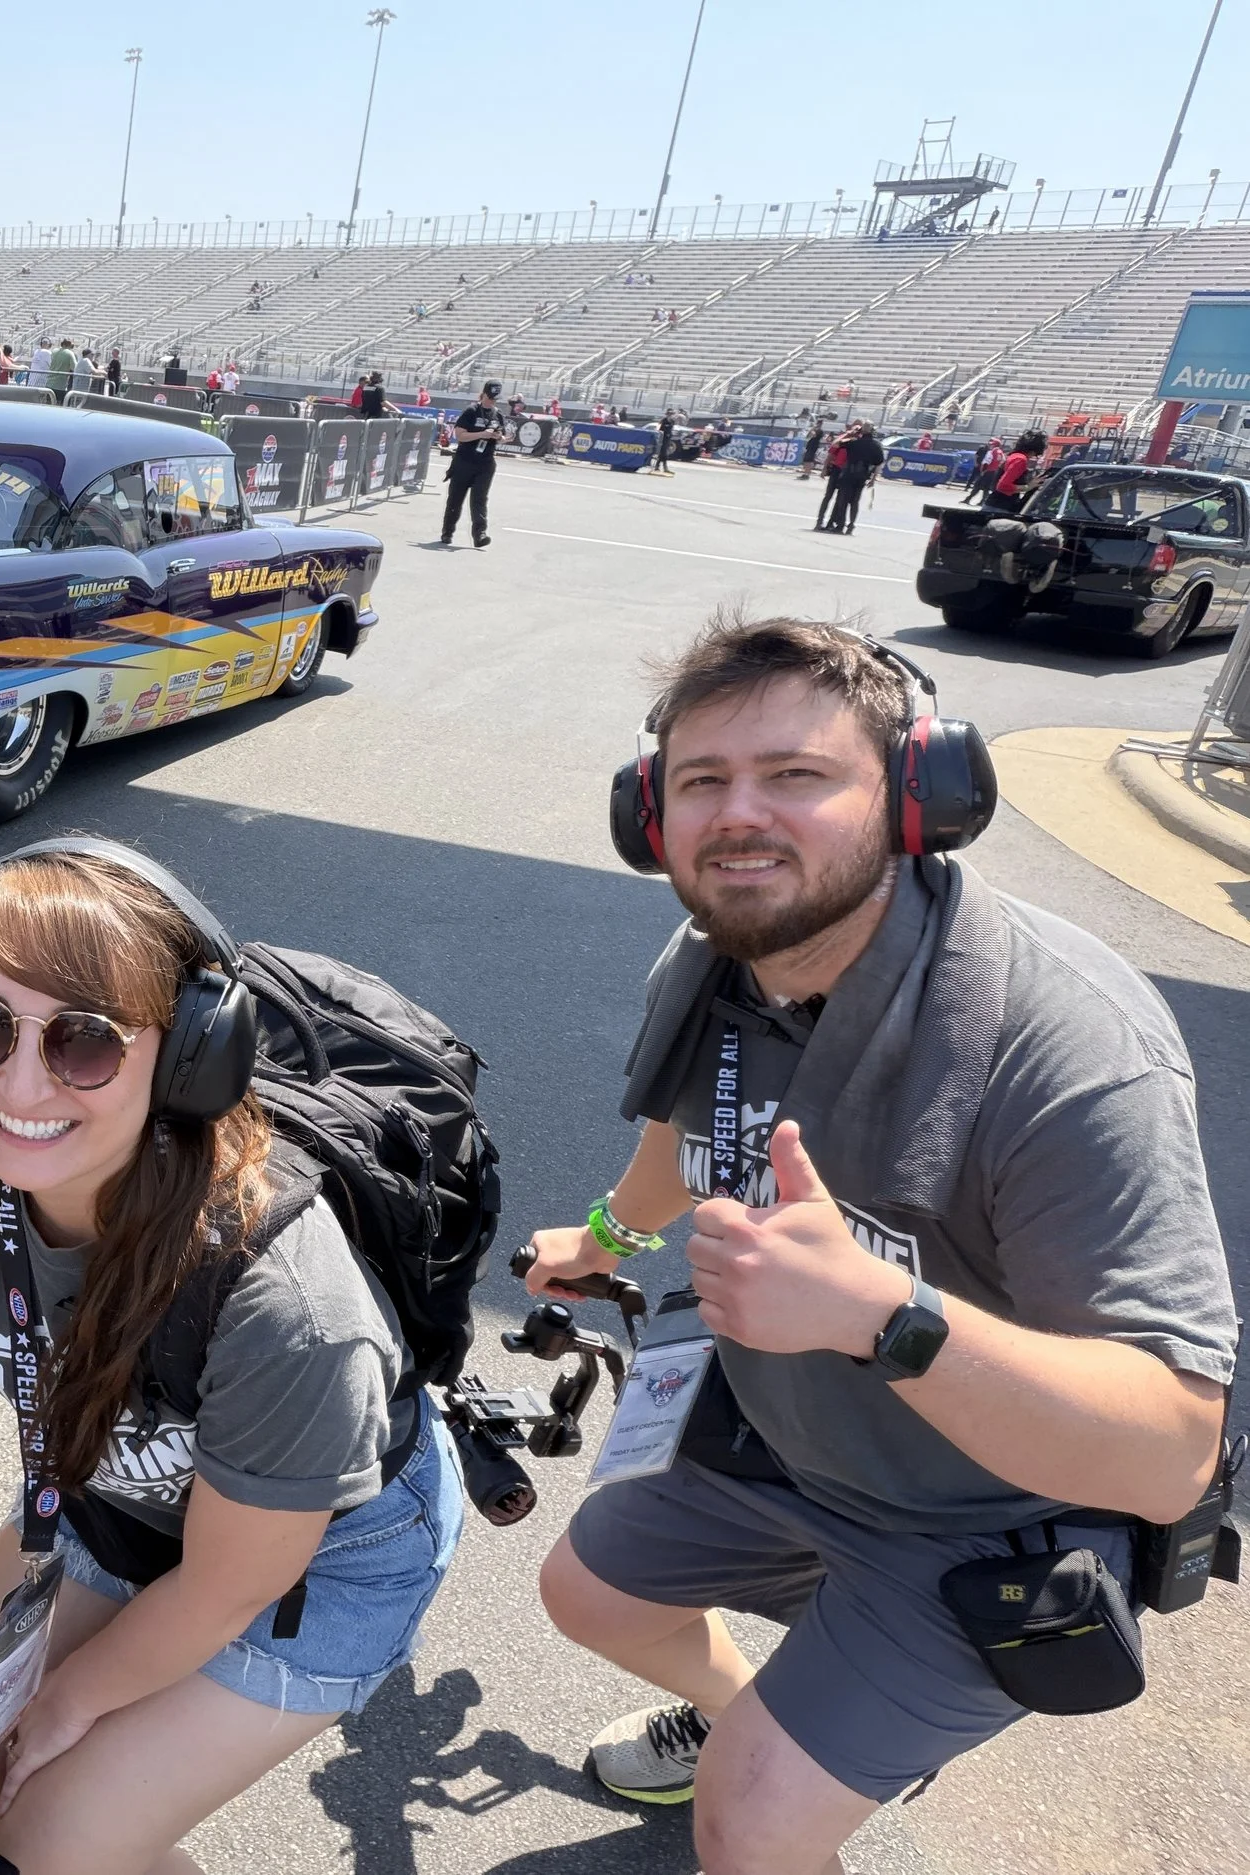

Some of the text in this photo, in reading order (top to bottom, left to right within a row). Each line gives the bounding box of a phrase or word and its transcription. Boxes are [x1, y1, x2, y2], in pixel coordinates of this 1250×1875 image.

[594, 440, 617, 452] AUTO
[617, 443, 646, 455] PARTS
[208, 561, 310, 599] Willard
[714, 1029, 739, 1163] SPEED FOR ALL
[18, 1603, 47, 1630] NHRA
